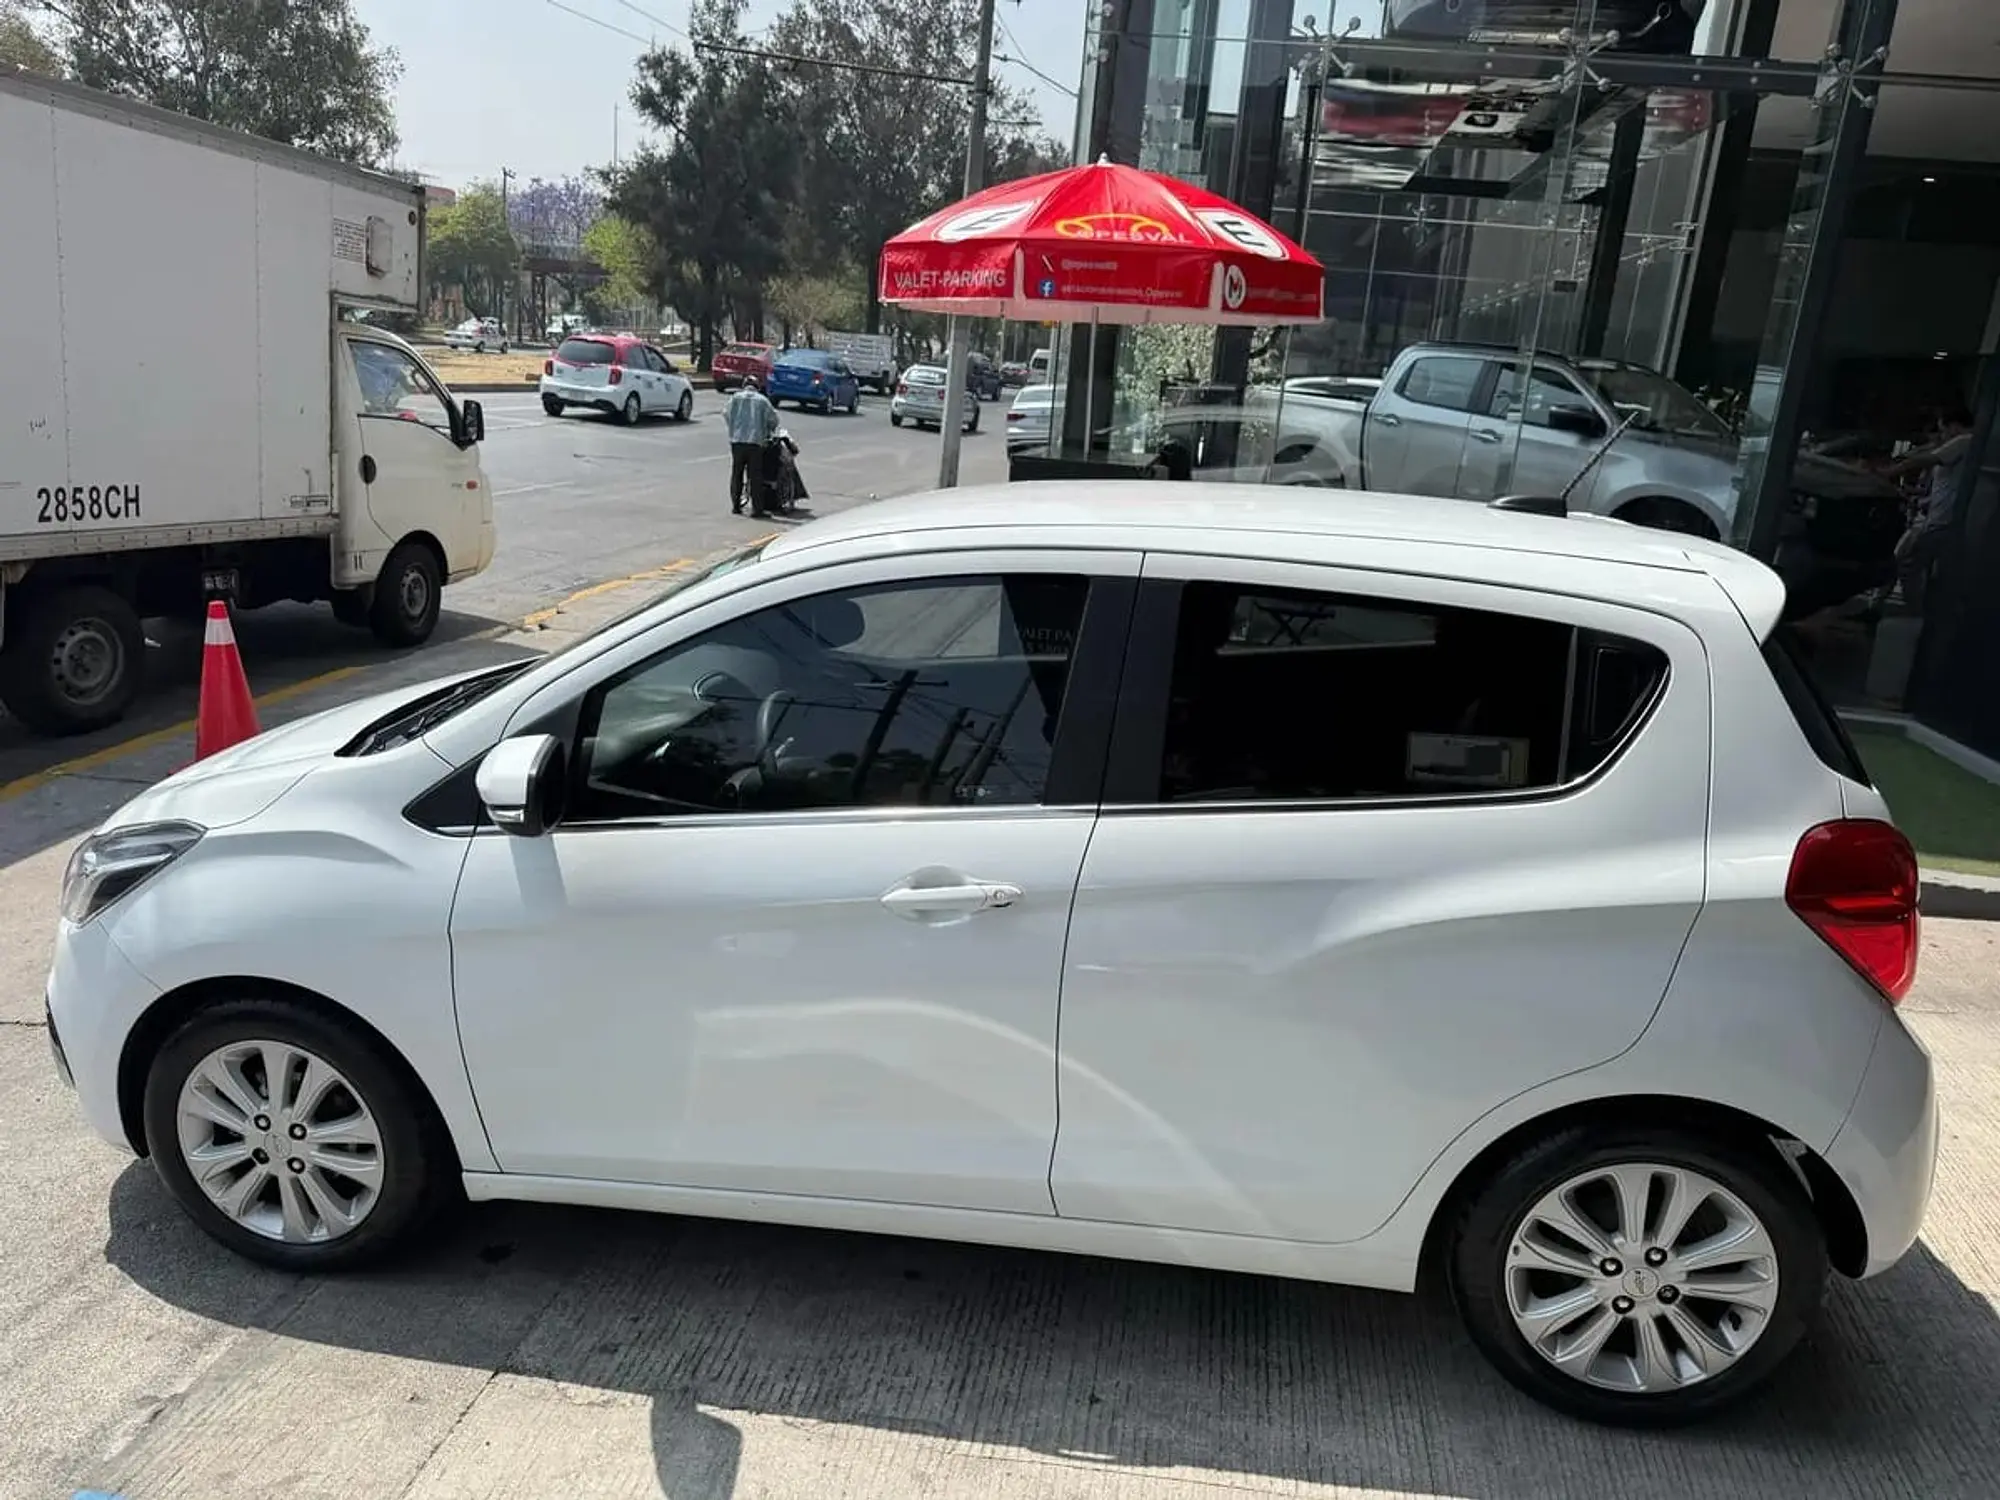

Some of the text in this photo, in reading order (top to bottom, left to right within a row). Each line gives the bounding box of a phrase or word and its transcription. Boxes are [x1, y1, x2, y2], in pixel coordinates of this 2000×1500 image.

[1213, 220, 1268, 248] E
[893, 268, 1007, 289] VALET-PARKING
[37, 483, 140, 523] 2858CH
